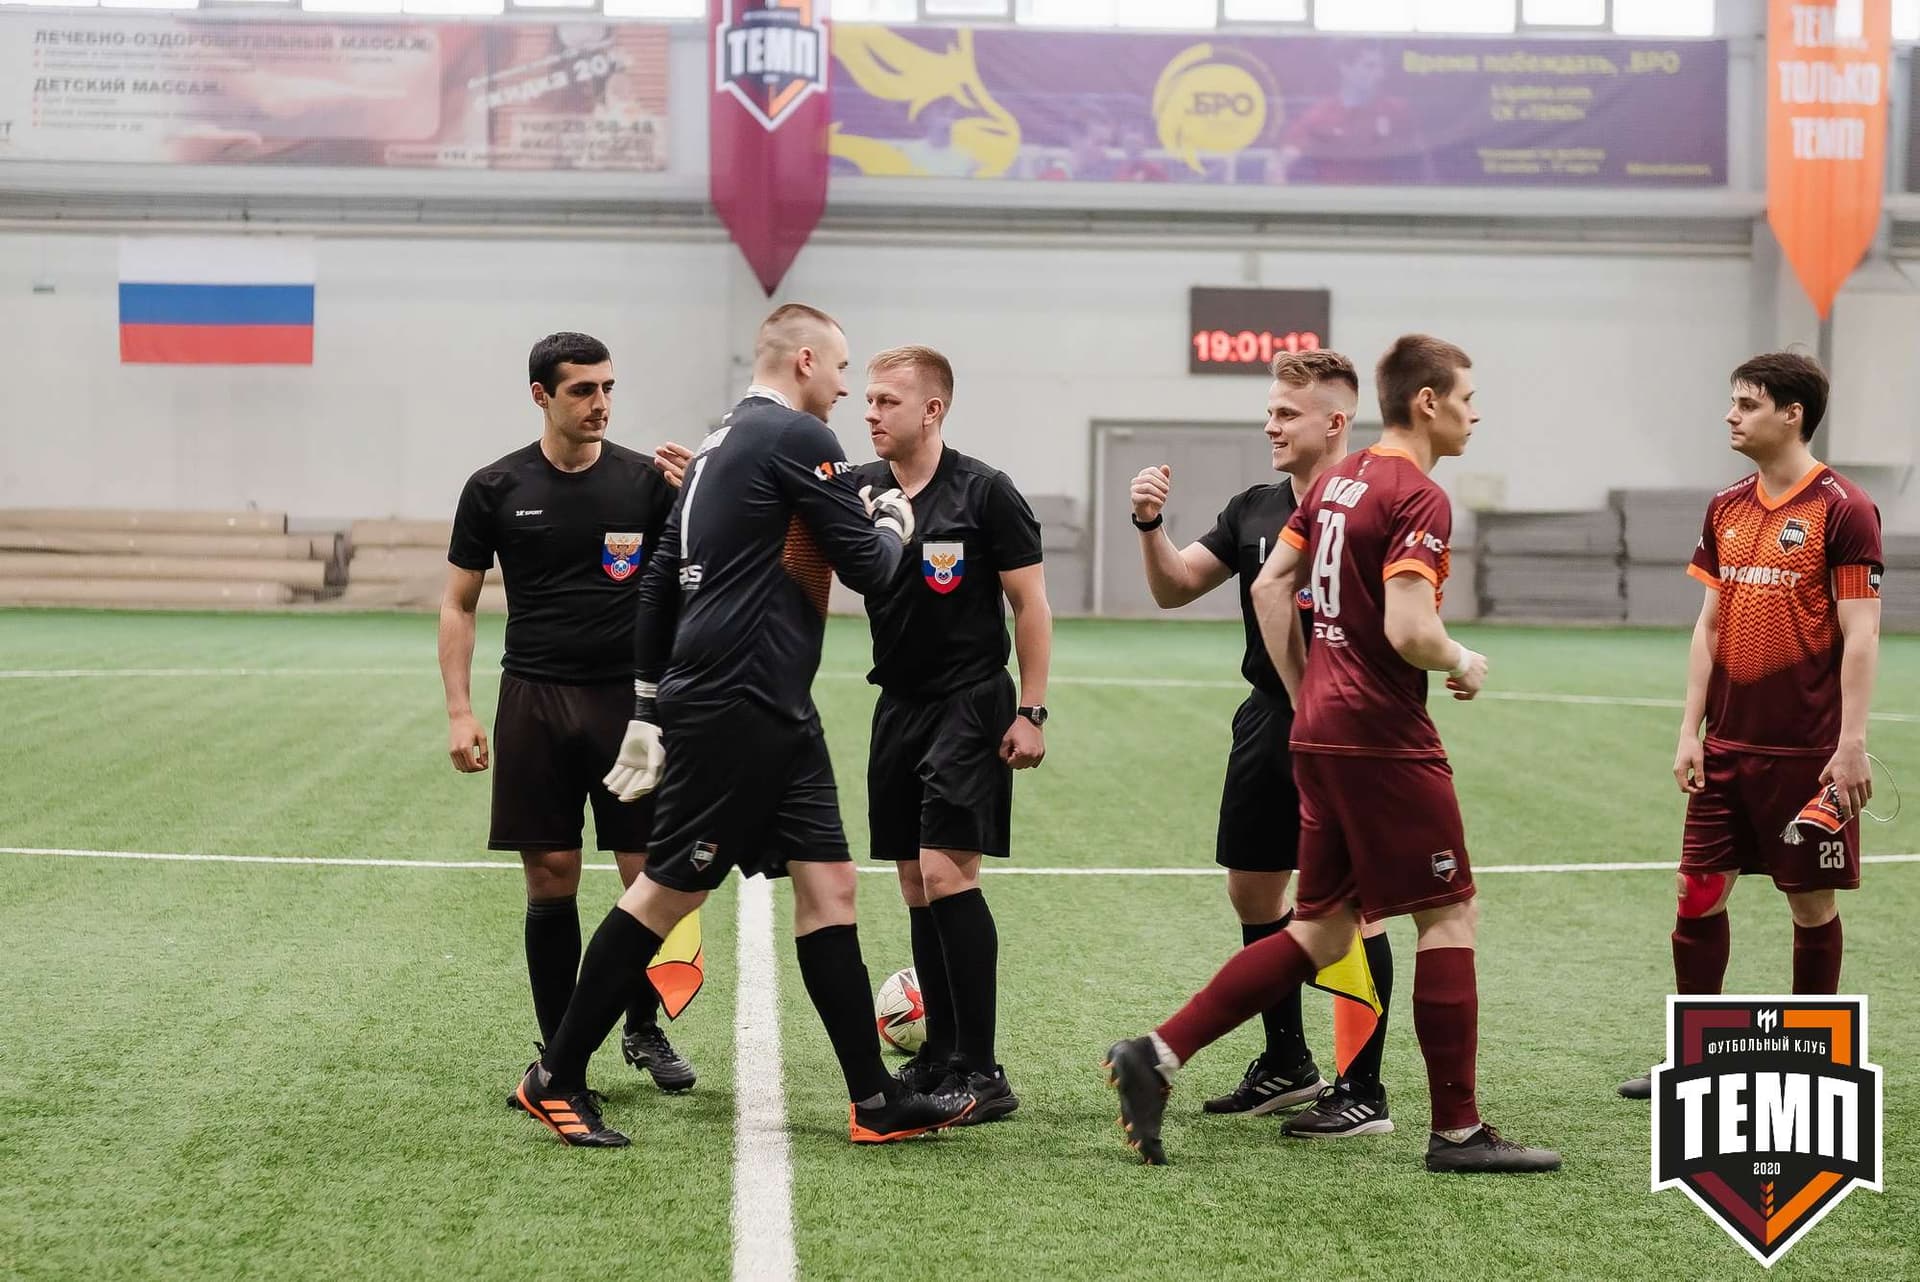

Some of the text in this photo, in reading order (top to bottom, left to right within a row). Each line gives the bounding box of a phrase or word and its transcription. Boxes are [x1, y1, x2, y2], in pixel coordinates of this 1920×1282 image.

[727, 27, 817, 77] ТЕМП
[34, 77, 126, 94] ДЕТСКИЙ
[1778, 60, 1881, 105] ТОЛЬКО
[1791, 116, 1865, 159] ТЕМП!
[680, 456, 707, 559] 1
[1782, 528, 1804, 545] ТЕМП
[1311, 509, 1346, 618] 19
[1819, 841, 1845, 869] 23
